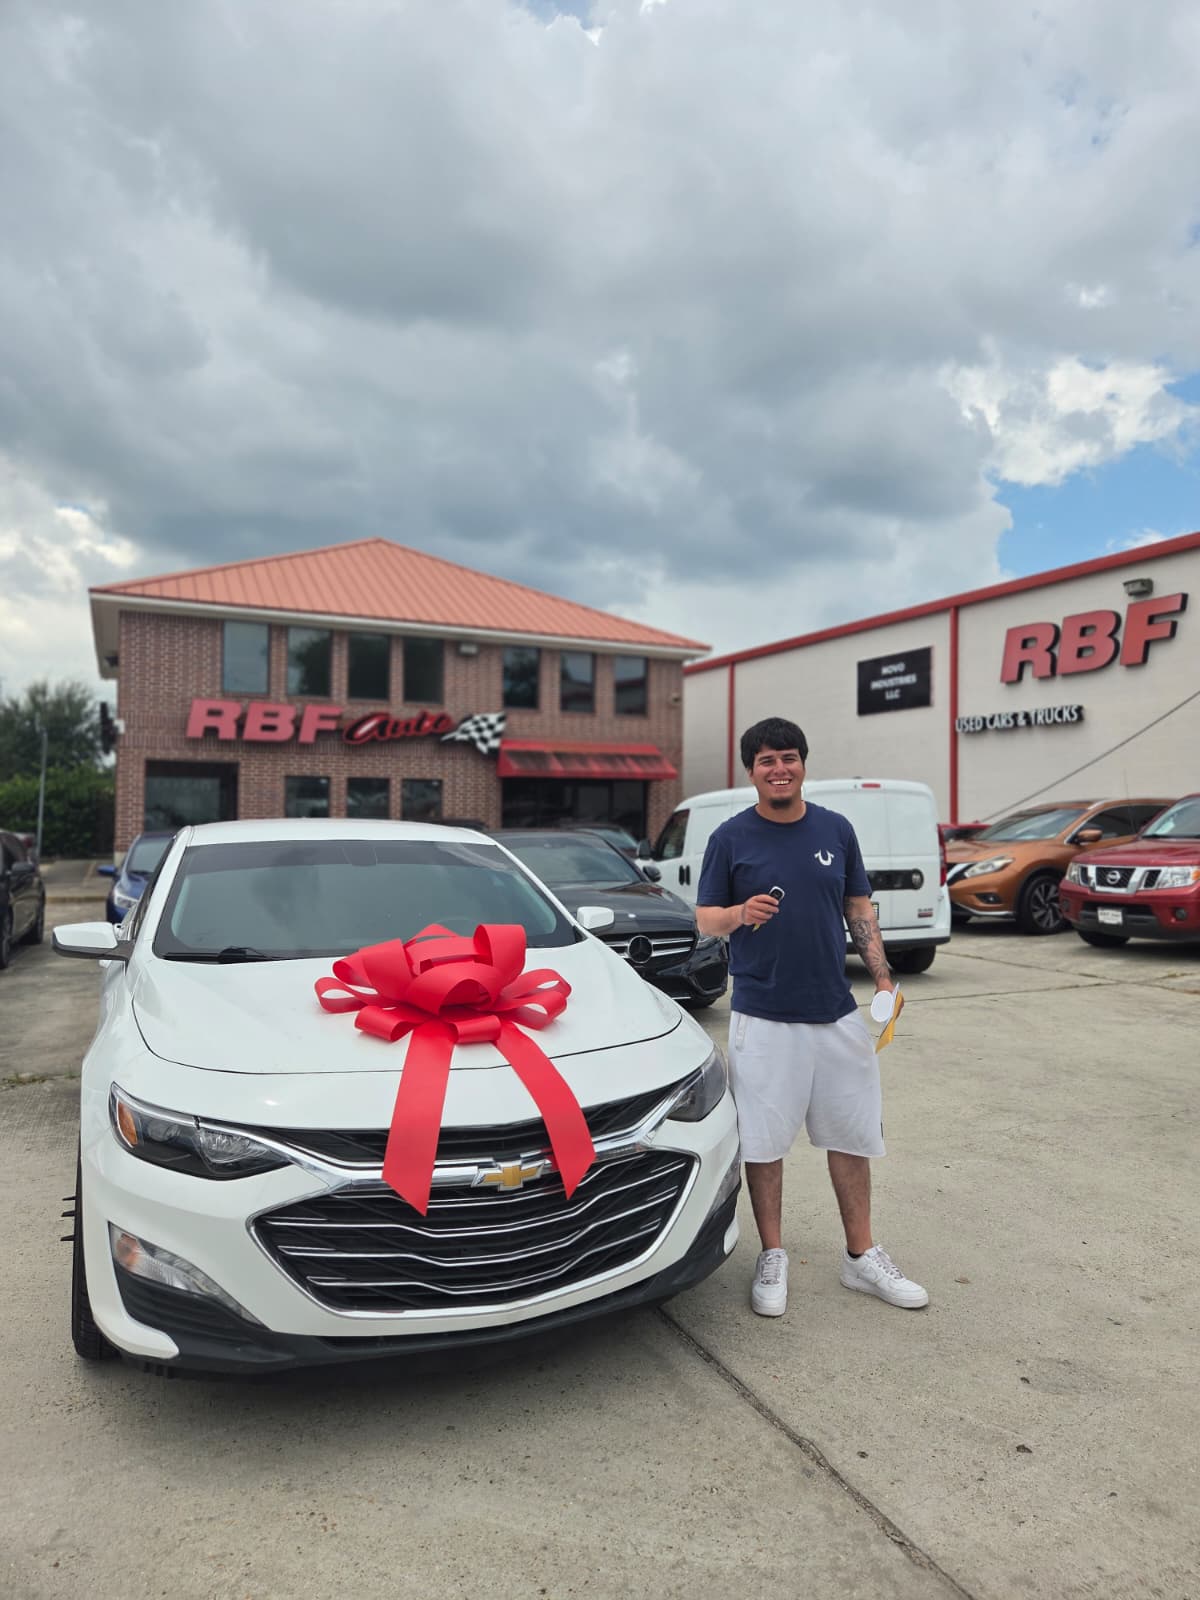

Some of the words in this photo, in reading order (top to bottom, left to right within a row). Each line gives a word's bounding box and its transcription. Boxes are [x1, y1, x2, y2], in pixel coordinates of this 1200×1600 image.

[1000, 592, 1187, 684] RBF
[186, 699, 343, 743] RBF
[344, 711, 453, 745] Auto
[955, 716, 983, 733] USED
[986, 713, 1014, 729] CARS
[1017, 711, 1027, 726] &
[1030, 704, 1079, 725] TRUCKS
